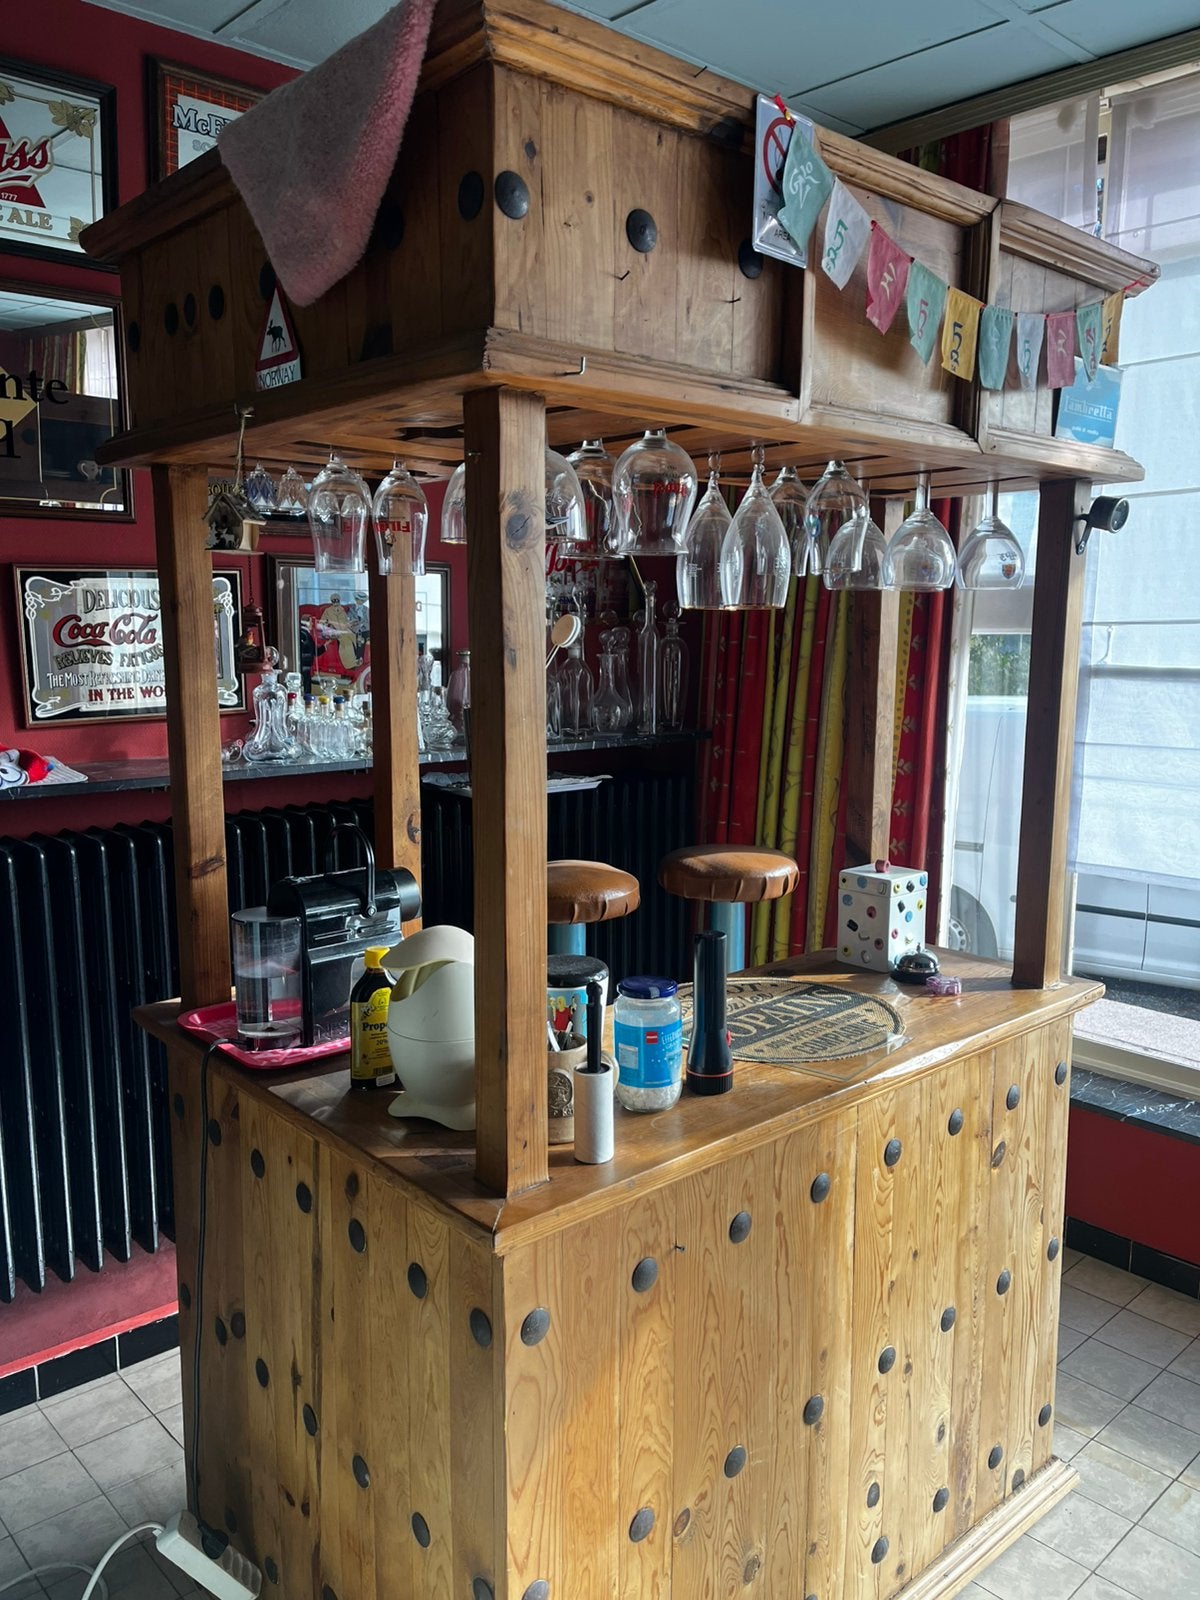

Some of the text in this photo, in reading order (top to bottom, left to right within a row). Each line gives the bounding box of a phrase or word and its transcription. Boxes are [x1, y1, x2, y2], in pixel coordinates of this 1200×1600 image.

[173, 104, 233, 138] McE
[7, 207, 53, 231] ALE
[259, 364, 296, 388] NORWAY
[82, 588, 161, 614] DELICIOUS
[53, 649, 113, 670] RELIEVES
[88, 684, 165, 702] IN THE WO
[362, 1021, 388, 1031] Prop
